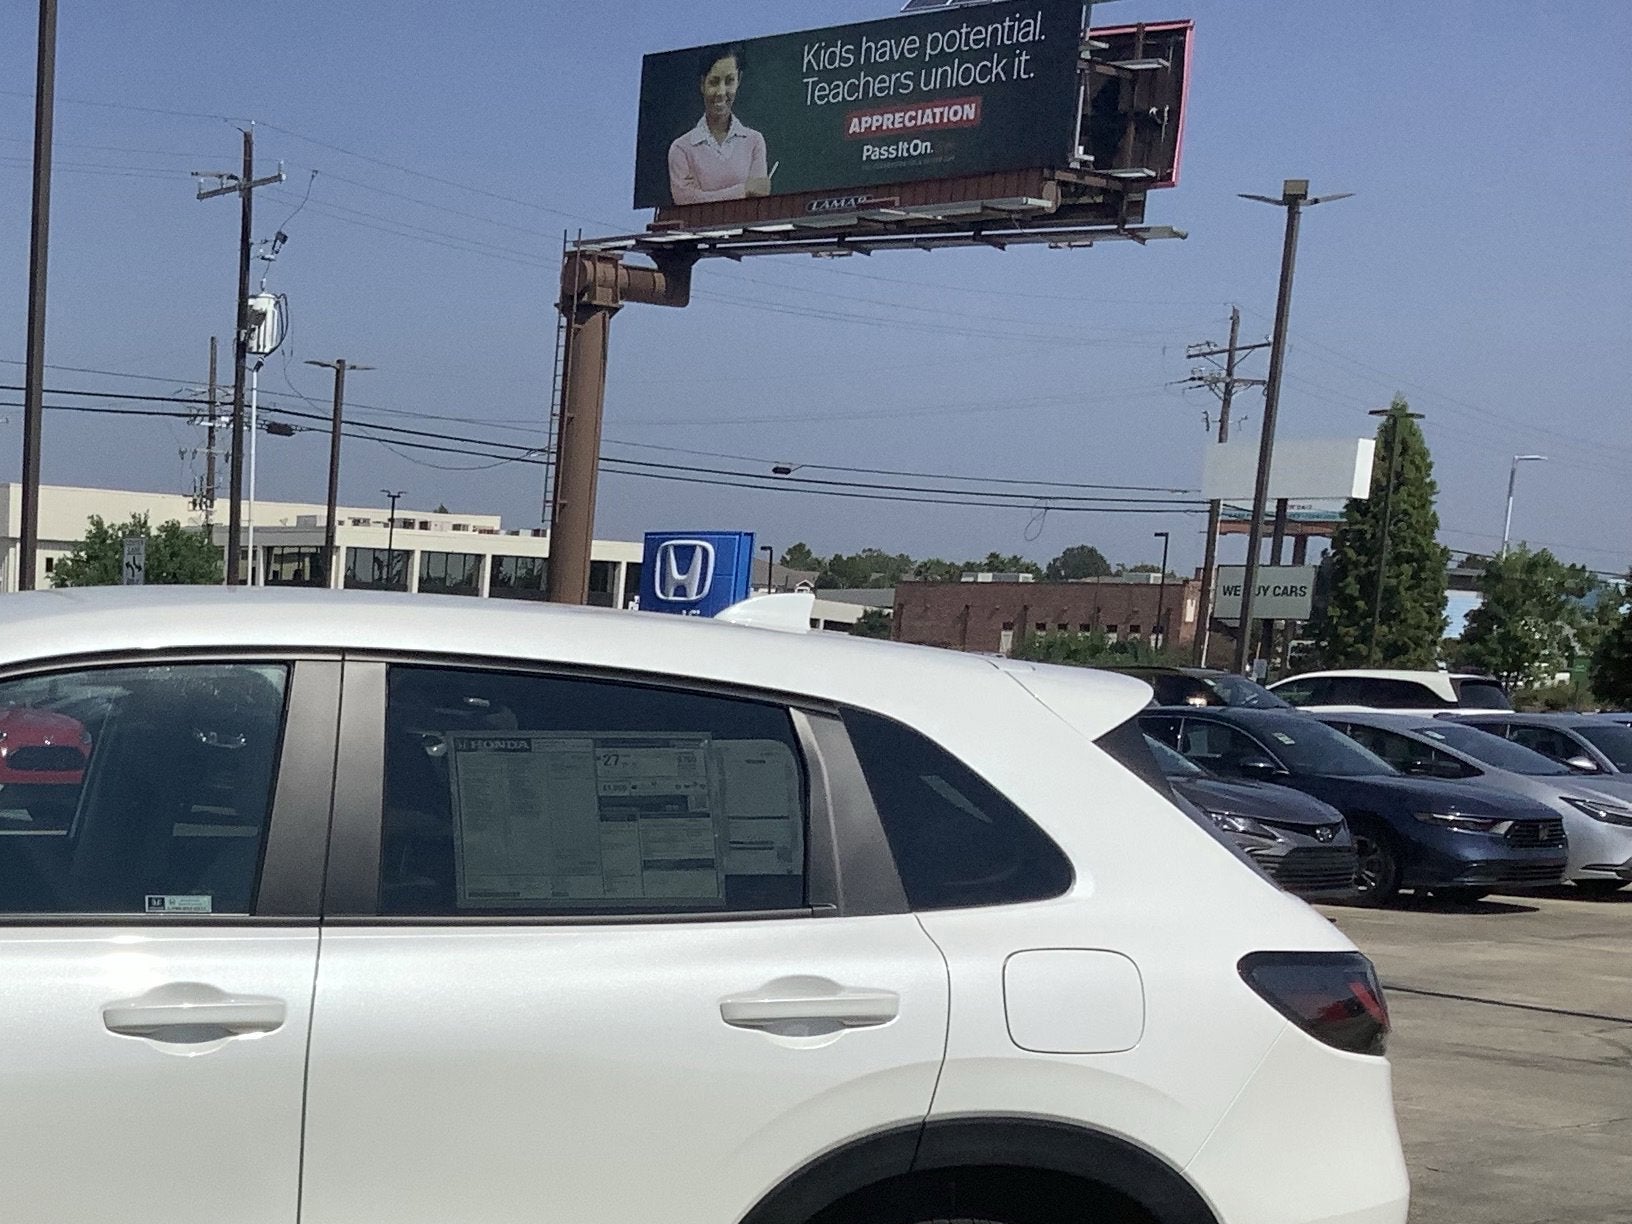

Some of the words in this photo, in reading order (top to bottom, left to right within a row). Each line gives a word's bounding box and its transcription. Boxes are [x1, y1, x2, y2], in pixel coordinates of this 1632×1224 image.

[803, 40, 854, 72] Kids
[860, 36, 920, 64] have
[925, 11, 1046, 61] potential.
[803, 70, 914, 105] Teachers
[920, 53, 1007, 91] unlock
[1013, 50, 1035, 79] it.
[848, 103, 976, 134] APPRECIATION
[1222, 585, 1241, 597] WE
[1272, 585, 1308, 597] CARS
[470, 740, 530, 750] HONDA
[602, 753, 620, 766] 27
